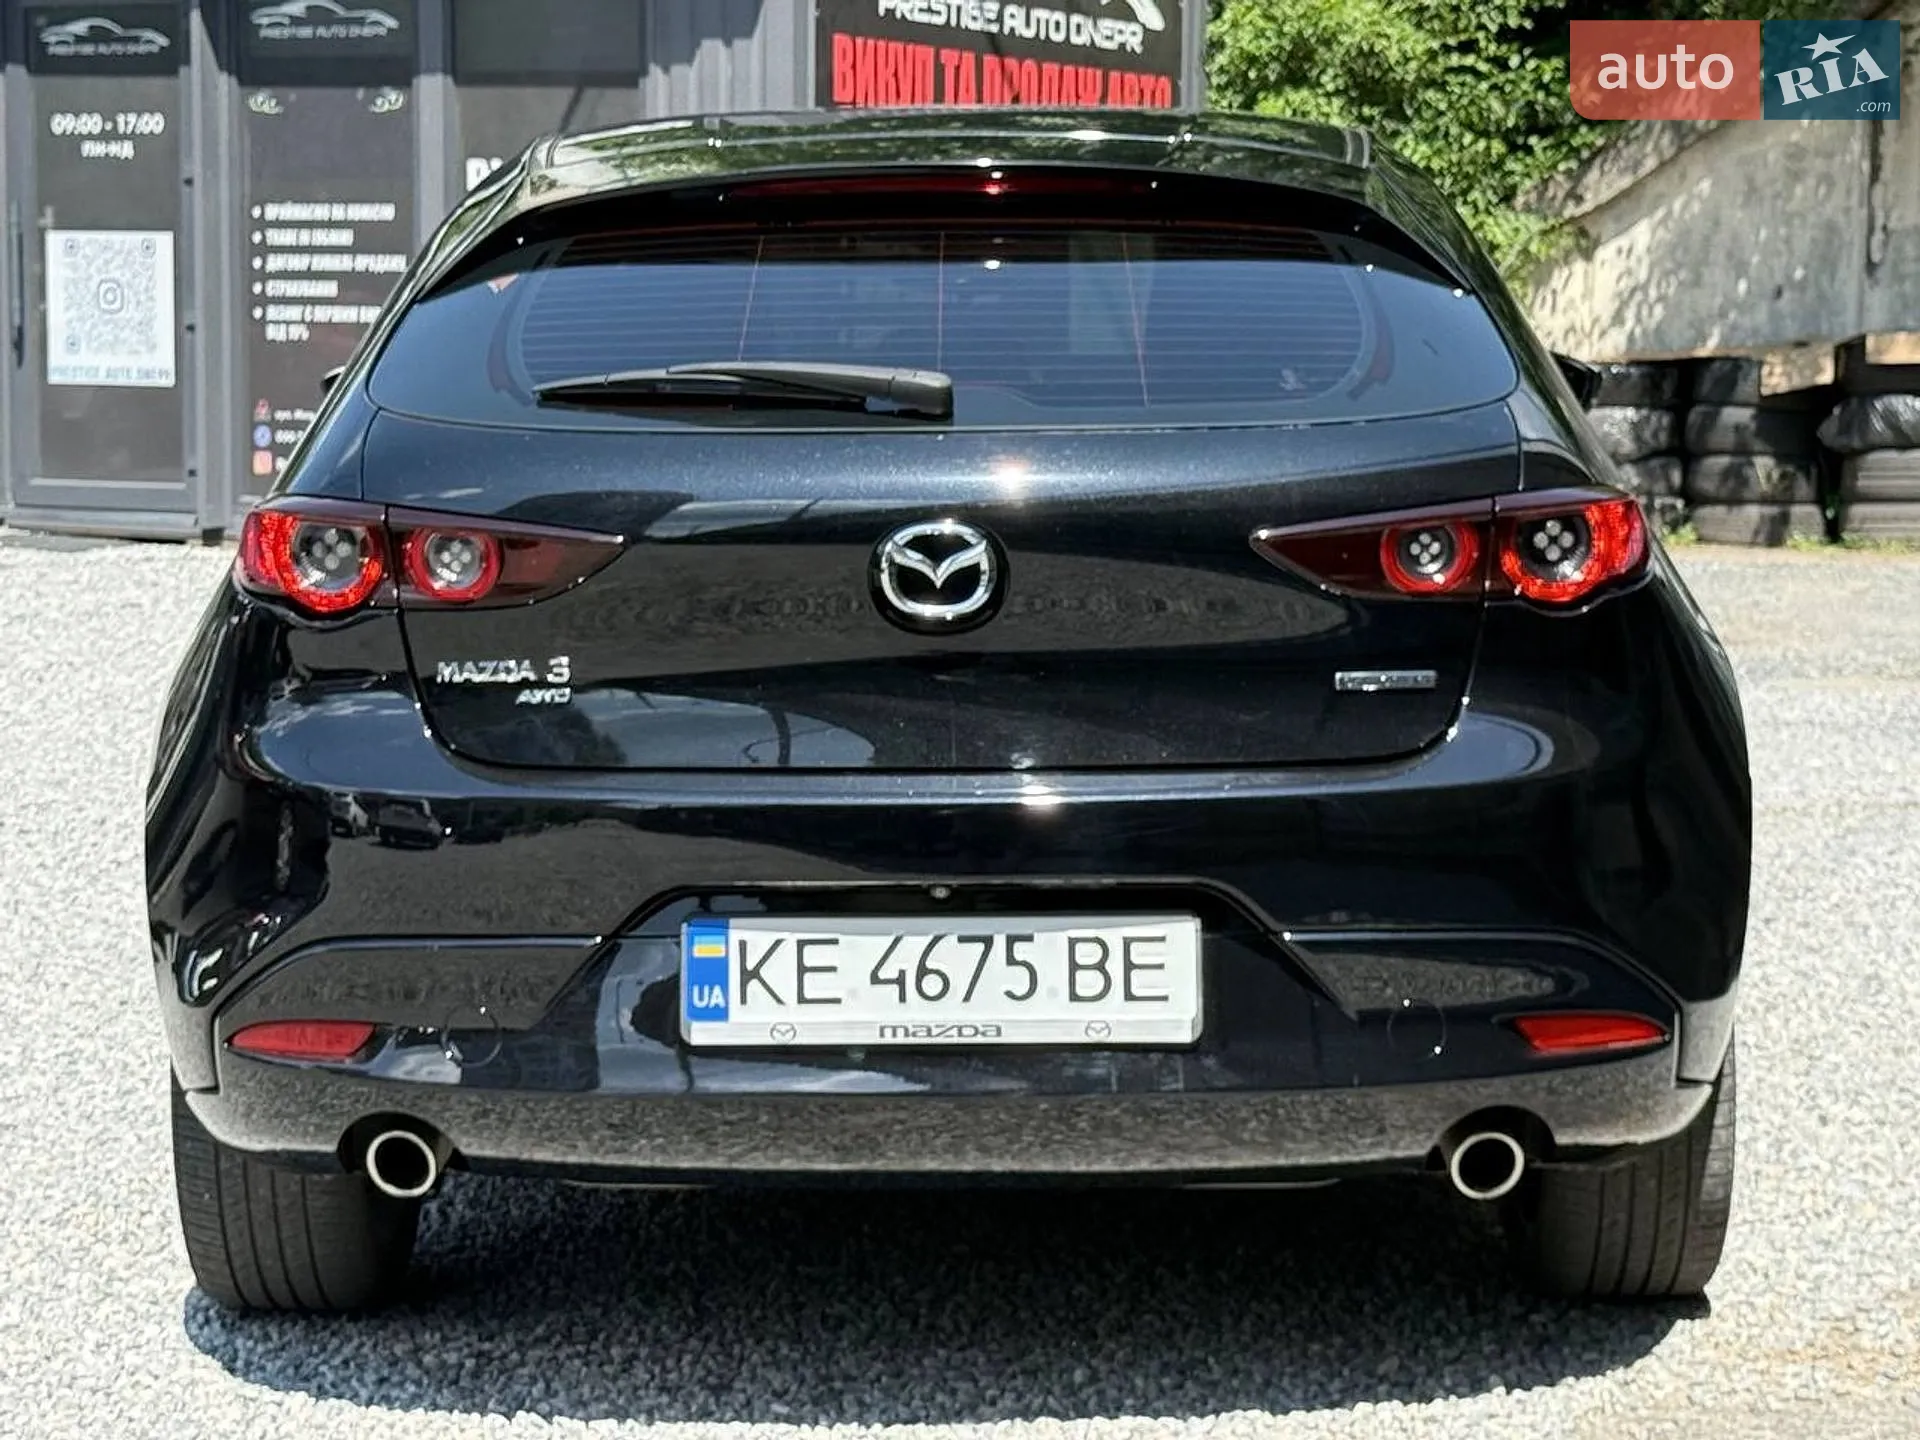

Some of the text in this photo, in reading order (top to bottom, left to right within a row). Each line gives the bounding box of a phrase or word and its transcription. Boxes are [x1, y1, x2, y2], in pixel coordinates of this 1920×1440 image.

[877, 0, 1144, 54] PRESTIGE AUTO DNEPR
[832, 32, 935, 108] ВИКУП
[940, 48, 976, 109] ТА
[50, 112, 103, 135] 09:00
[115, 111, 165, 135] 17:00
[436, 655, 571, 684] MAZDA 3
[738, 934, 1170, 1006] KE 4675 BE
[693, 984, 726, 1009] UA
